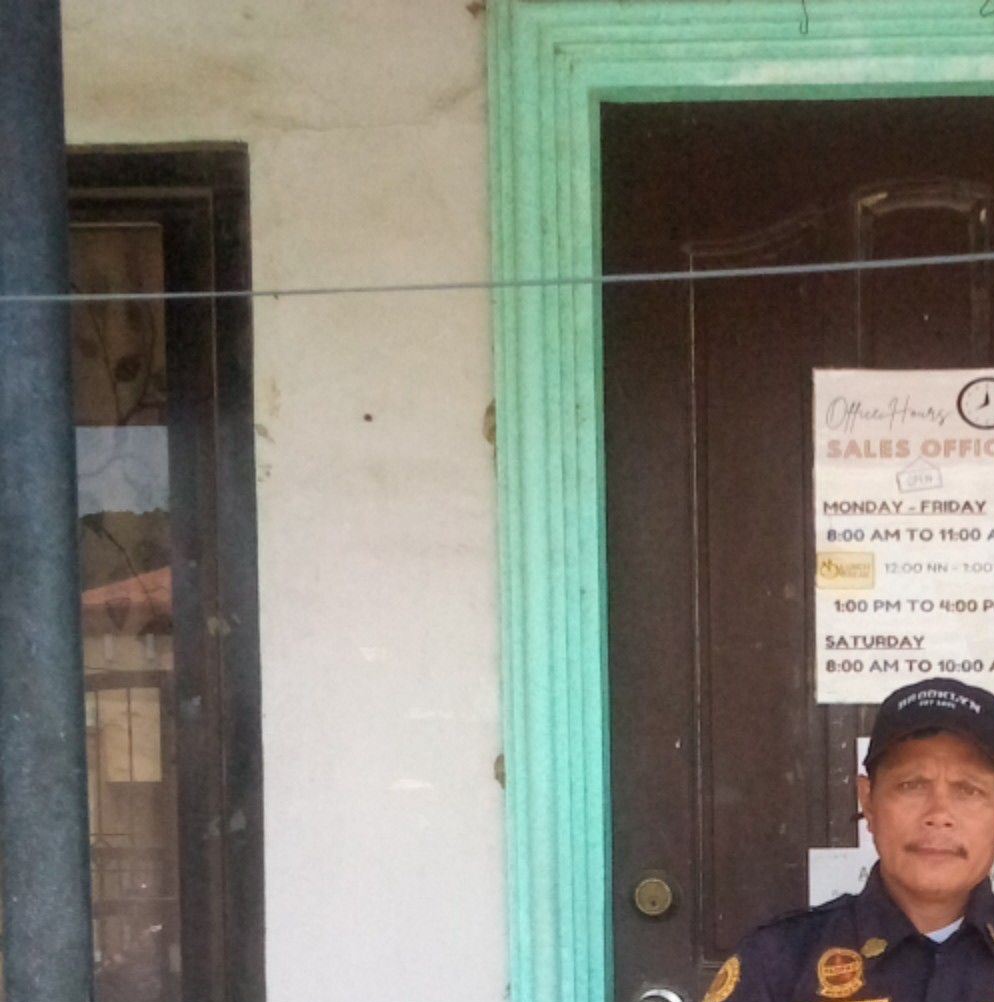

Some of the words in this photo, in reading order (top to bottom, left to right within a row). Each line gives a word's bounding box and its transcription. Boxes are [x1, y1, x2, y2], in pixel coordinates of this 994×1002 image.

[826, 396, 885, 433] Office
[888, 395, 950, 431] Hours
[826, 438, 911, 459] SALES
[823, 500, 903, 514] MONDAY
[921, 500, 987, 513] FRIDAY
[826, 528, 865, 542] 8:00
[870, 528, 900, 541] AM
[907, 528, 934, 541] TO
[939, 528, 981, 541] 11:00
[884, 562, 923, 574] 12:00
[927, 562, 948, 573] NN
[963, 562, 992, 573] 1:00
[834, 600, 868, 613] 1:00
[873, 600, 901, 612] PM
[907, 600, 934, 613] TO
[939, 600, 978, 612] 4:00
[825, 635, 925, 648] SATURDAY
[825, 659, 864, 673] 8:00
[869, 659, 899, 673] AM
[906, 660, 933, 673] TO
[938, 659, 984, 673] 10:00
[897, 689, 981, 714] BROOKLYN
